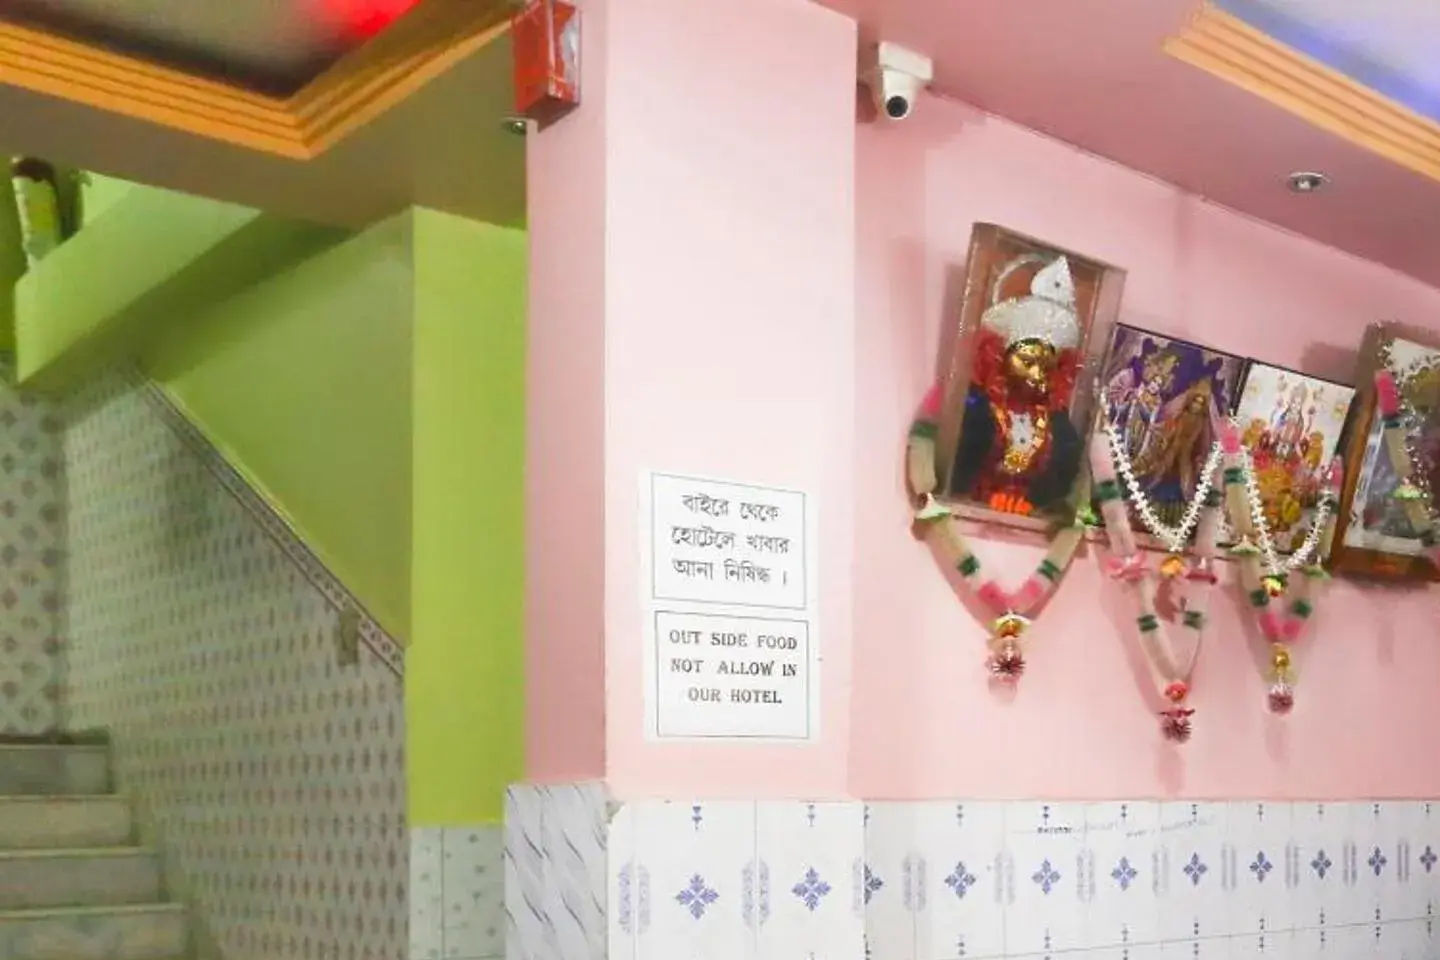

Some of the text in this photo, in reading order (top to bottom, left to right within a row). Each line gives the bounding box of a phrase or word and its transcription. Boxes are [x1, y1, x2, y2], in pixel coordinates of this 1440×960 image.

[680, 493, 780, 521] বাইরে থেকে
[671, 525, 790, 553] হোটেলে খাবার
[672, 559, 714, 580] আনা
[669, 629, 797, 650] OUT SIDE FOOD
[670, 658, 797, 676] NOT ALLOW IN
[688, 687, 782, 703] OUR HOTEL
